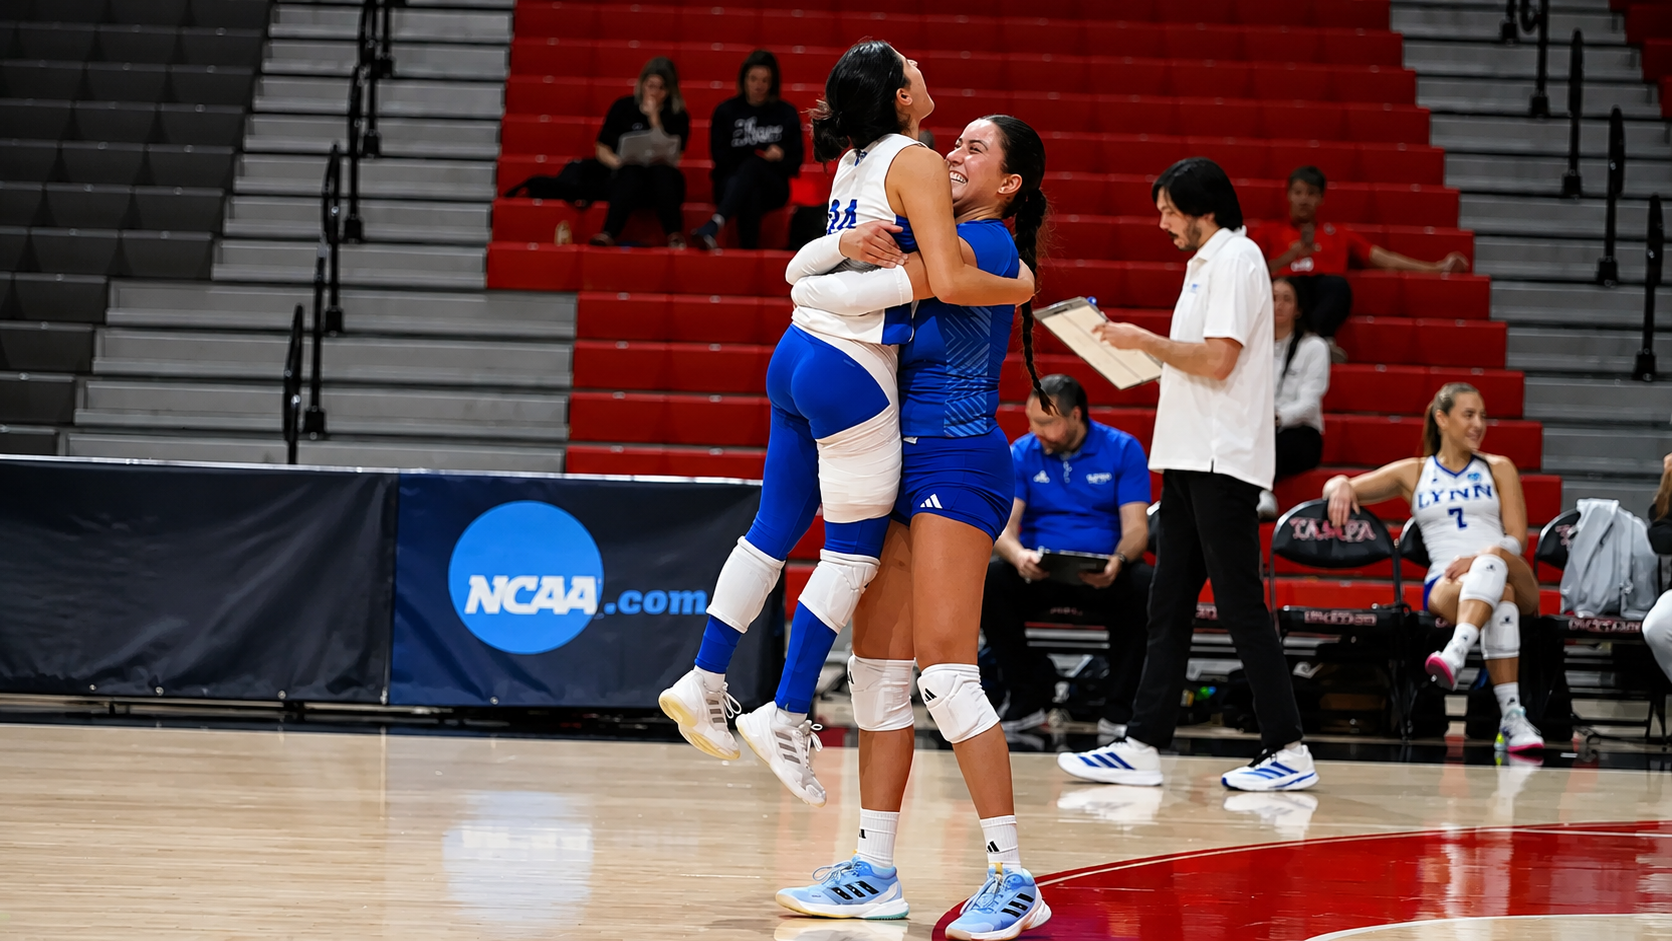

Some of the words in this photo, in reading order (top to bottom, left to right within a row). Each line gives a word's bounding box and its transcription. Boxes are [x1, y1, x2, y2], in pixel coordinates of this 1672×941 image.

[1418, 484, 1492, 509] LYNN
[1448, 507, 1467, 529] 7
[464, 575, 598, 615] NCAA
